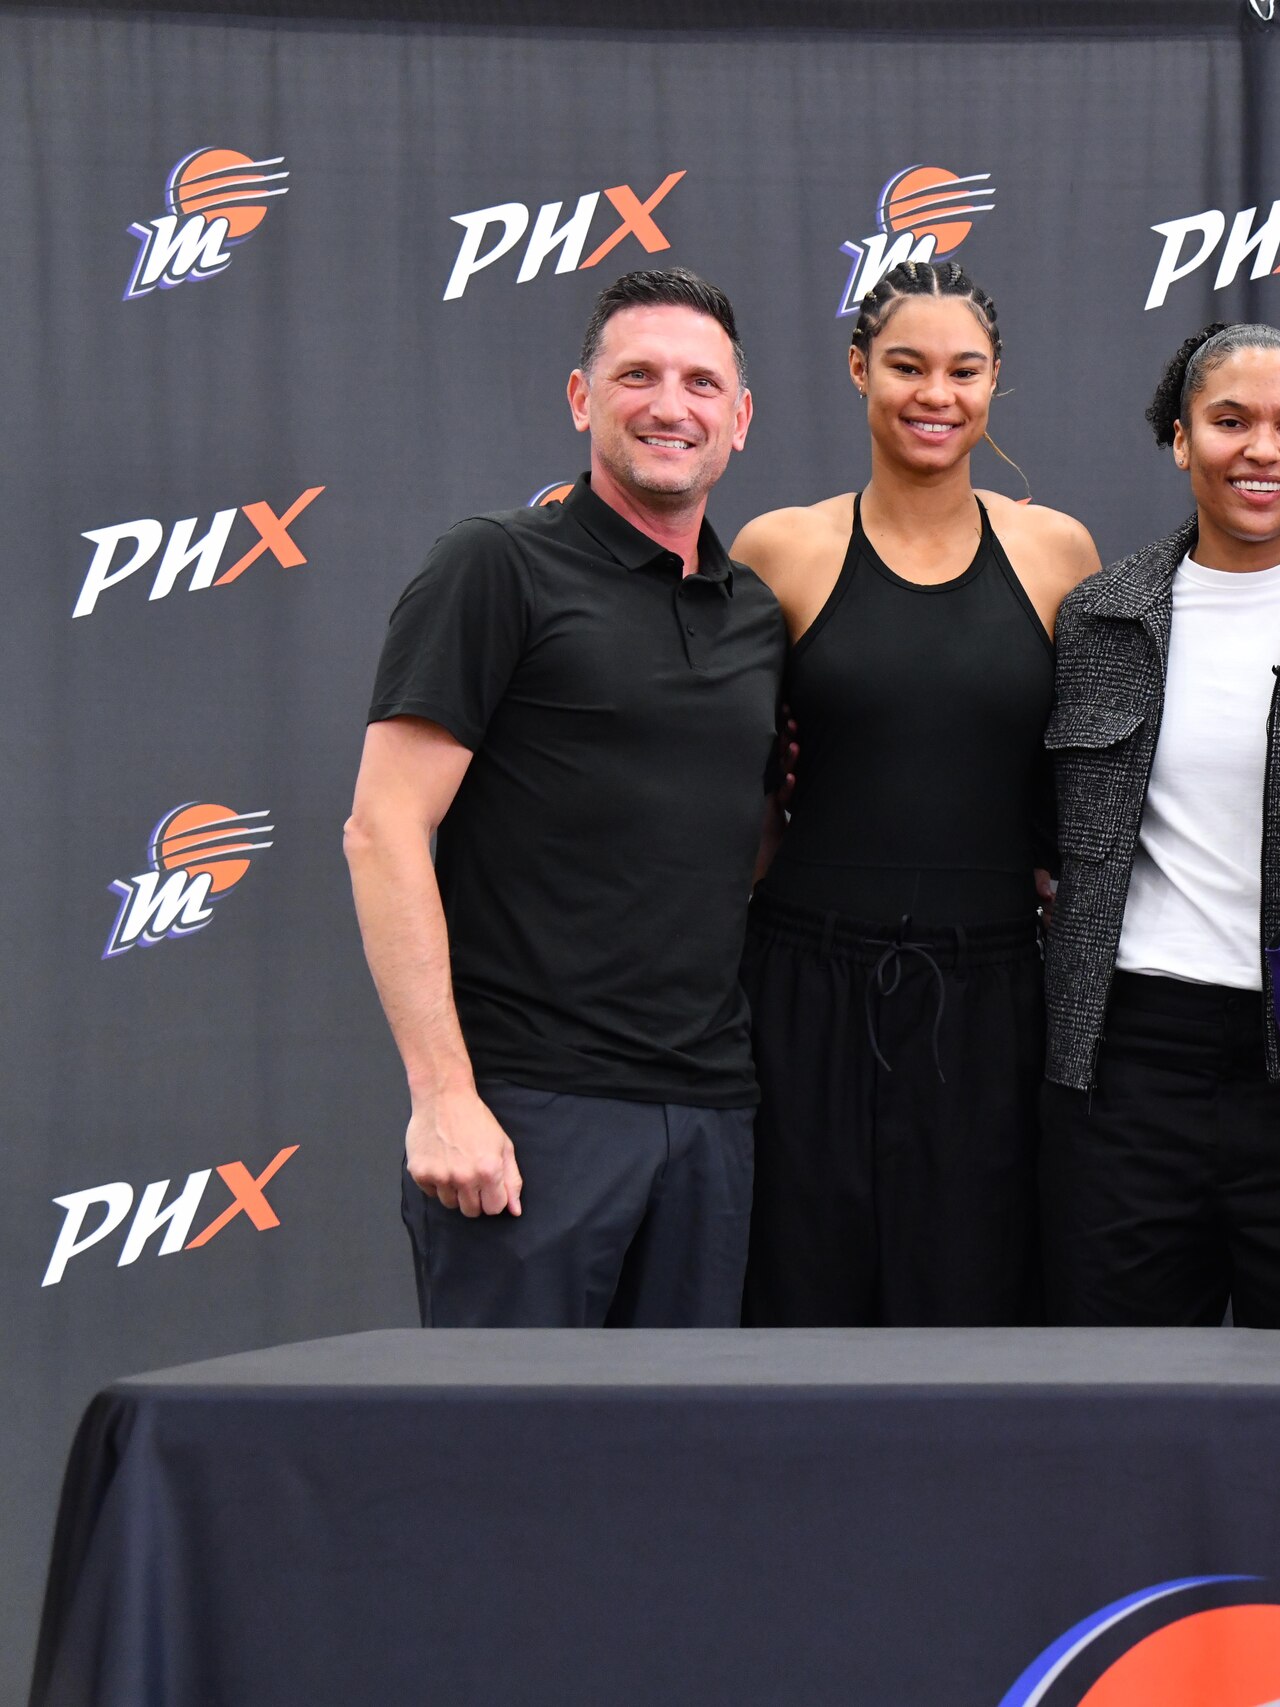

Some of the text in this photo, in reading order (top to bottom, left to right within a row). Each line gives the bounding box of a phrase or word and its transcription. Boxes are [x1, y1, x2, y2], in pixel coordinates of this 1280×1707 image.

[443, 170, 688, 301] PHX
[72, 486, 326, 618] PHX
[41, 1145, 300, 1288] PHX
